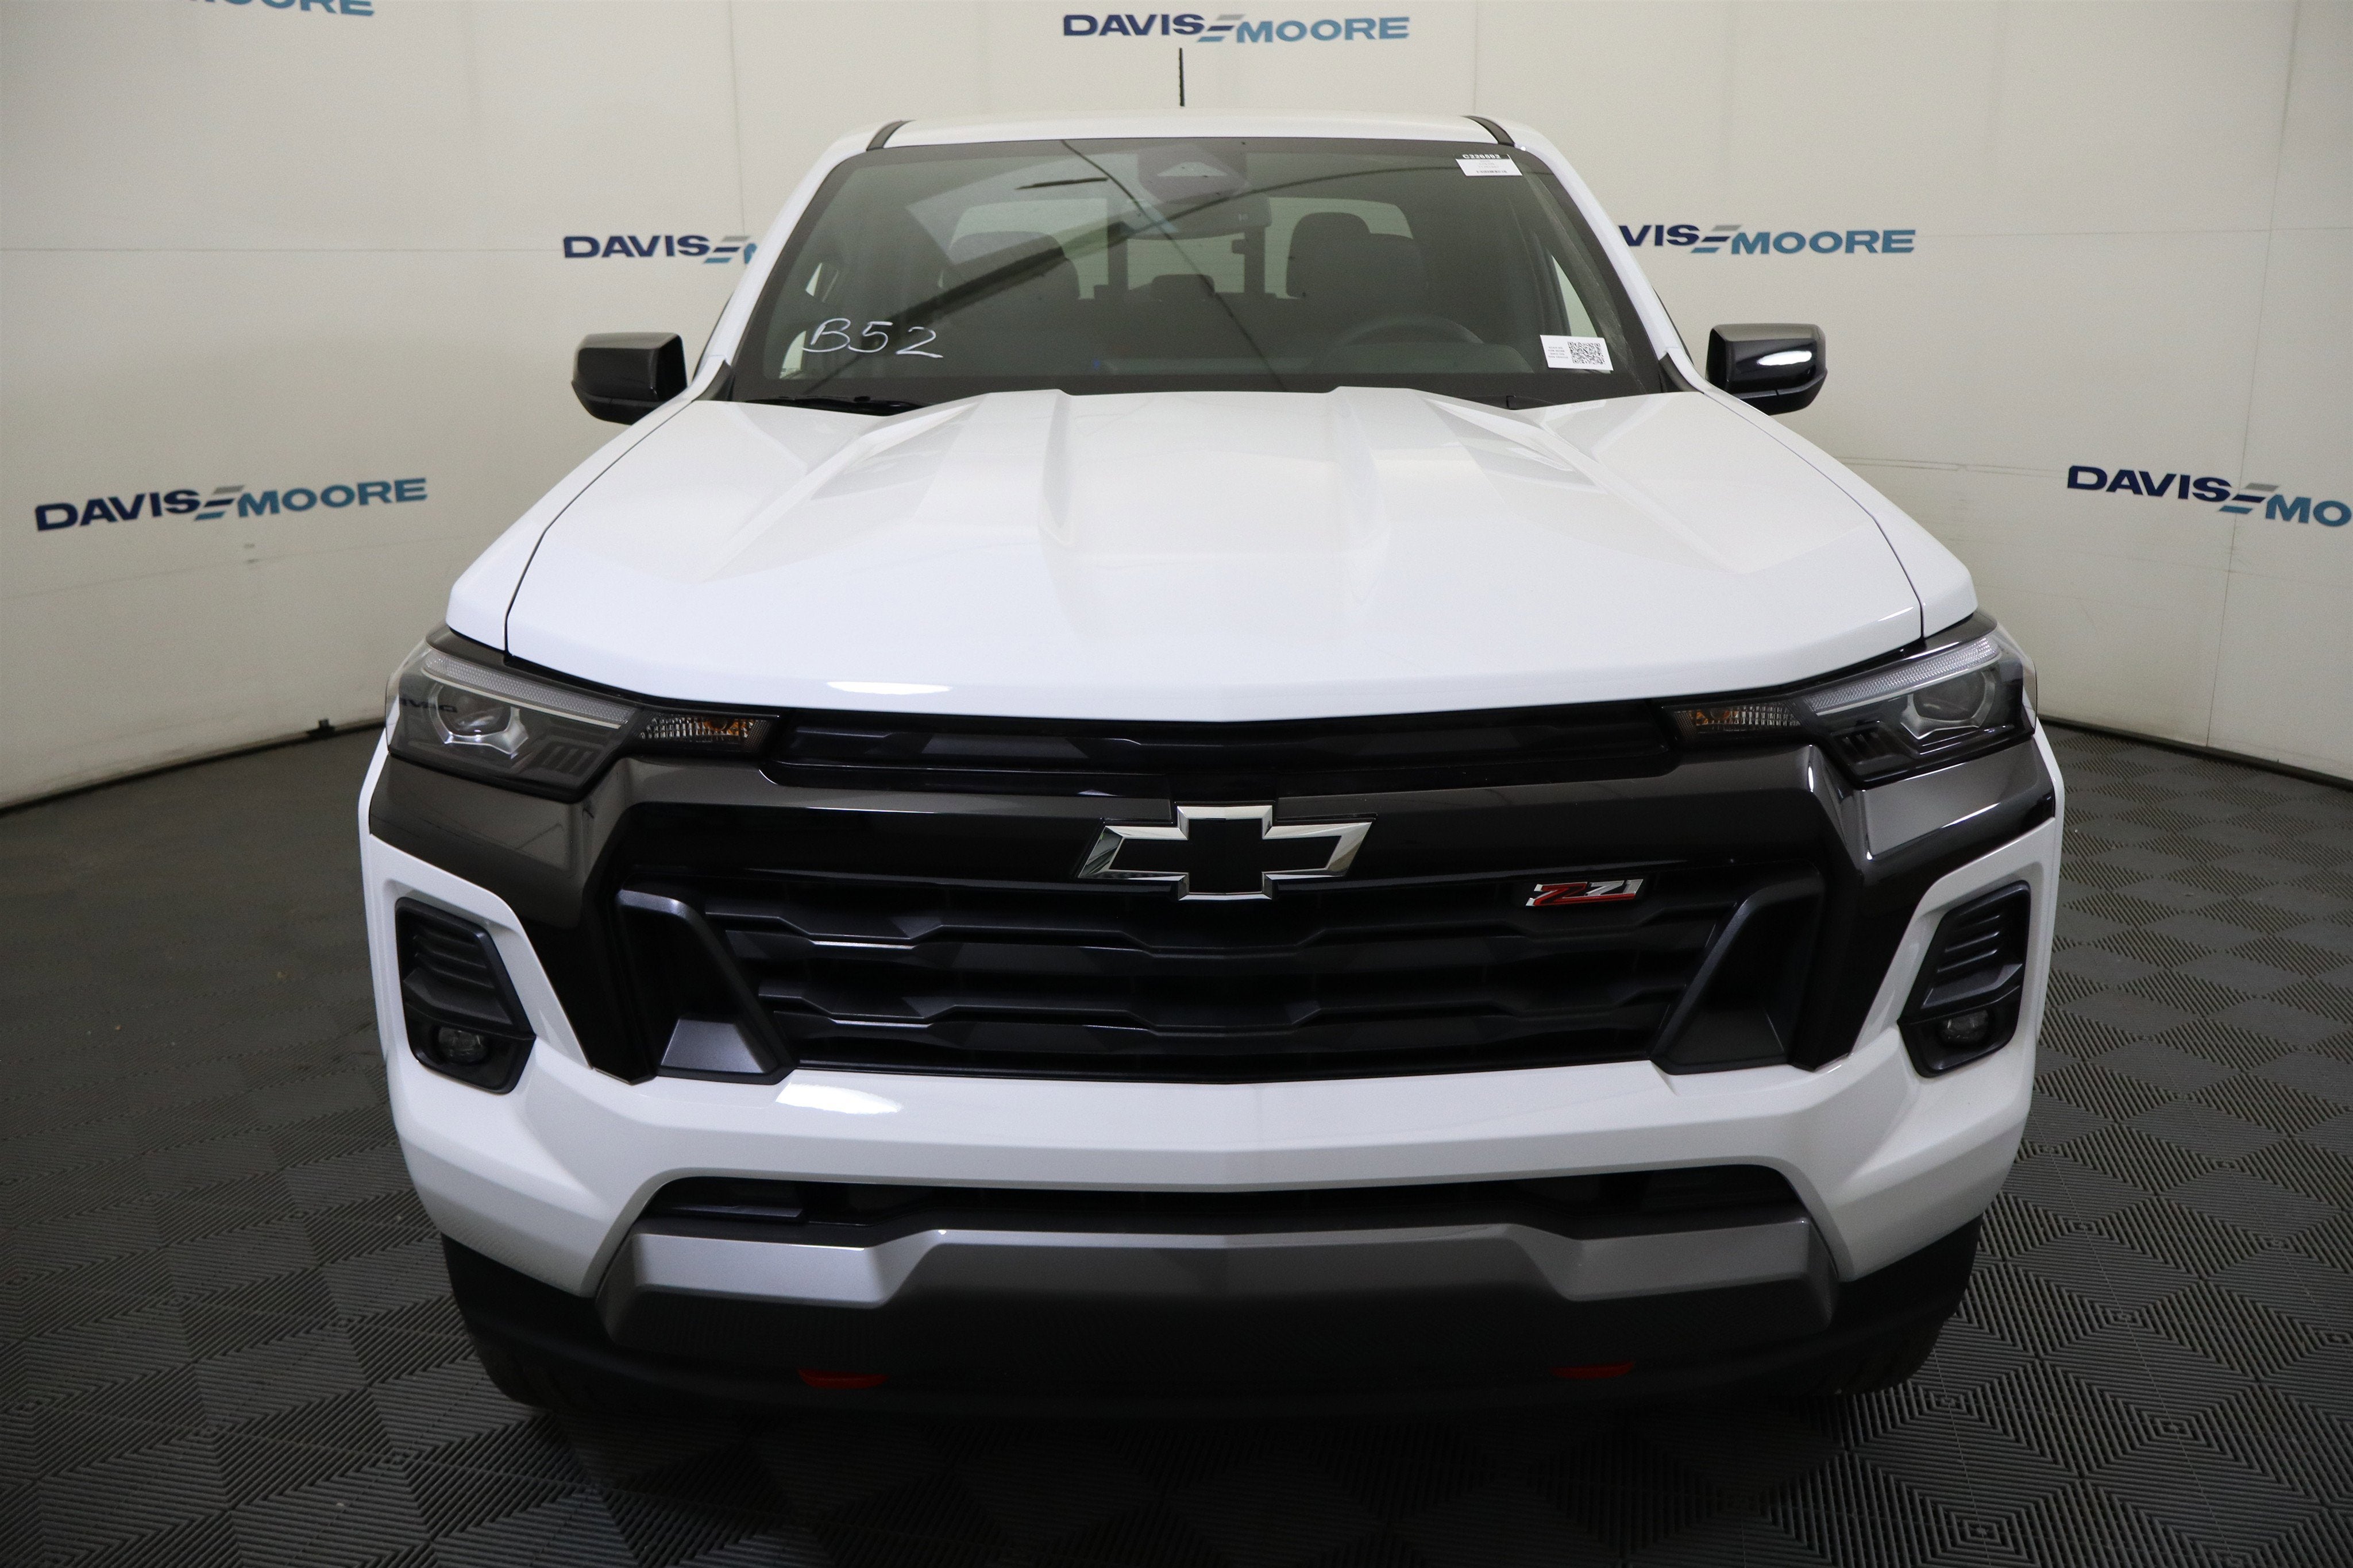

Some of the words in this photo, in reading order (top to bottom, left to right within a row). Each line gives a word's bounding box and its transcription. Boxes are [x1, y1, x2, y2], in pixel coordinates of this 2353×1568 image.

[1063, 13, 1205, 37] DAVIS
[1237, 17, 1410, 43] MOORE
[562, 234, 711, 258] DAVIS
[1731, 229, 1916, 255] MOORE
[802, 318, 943, 358] B52
[34, 489, 202, 532] DAVIS
[237, 477, 427, 518] MOORE
[2067, 465, 2232, 503] DAVIS
[2265, 494, 2352, 528] MO
[1526, 879, 1644, 906] Z71
